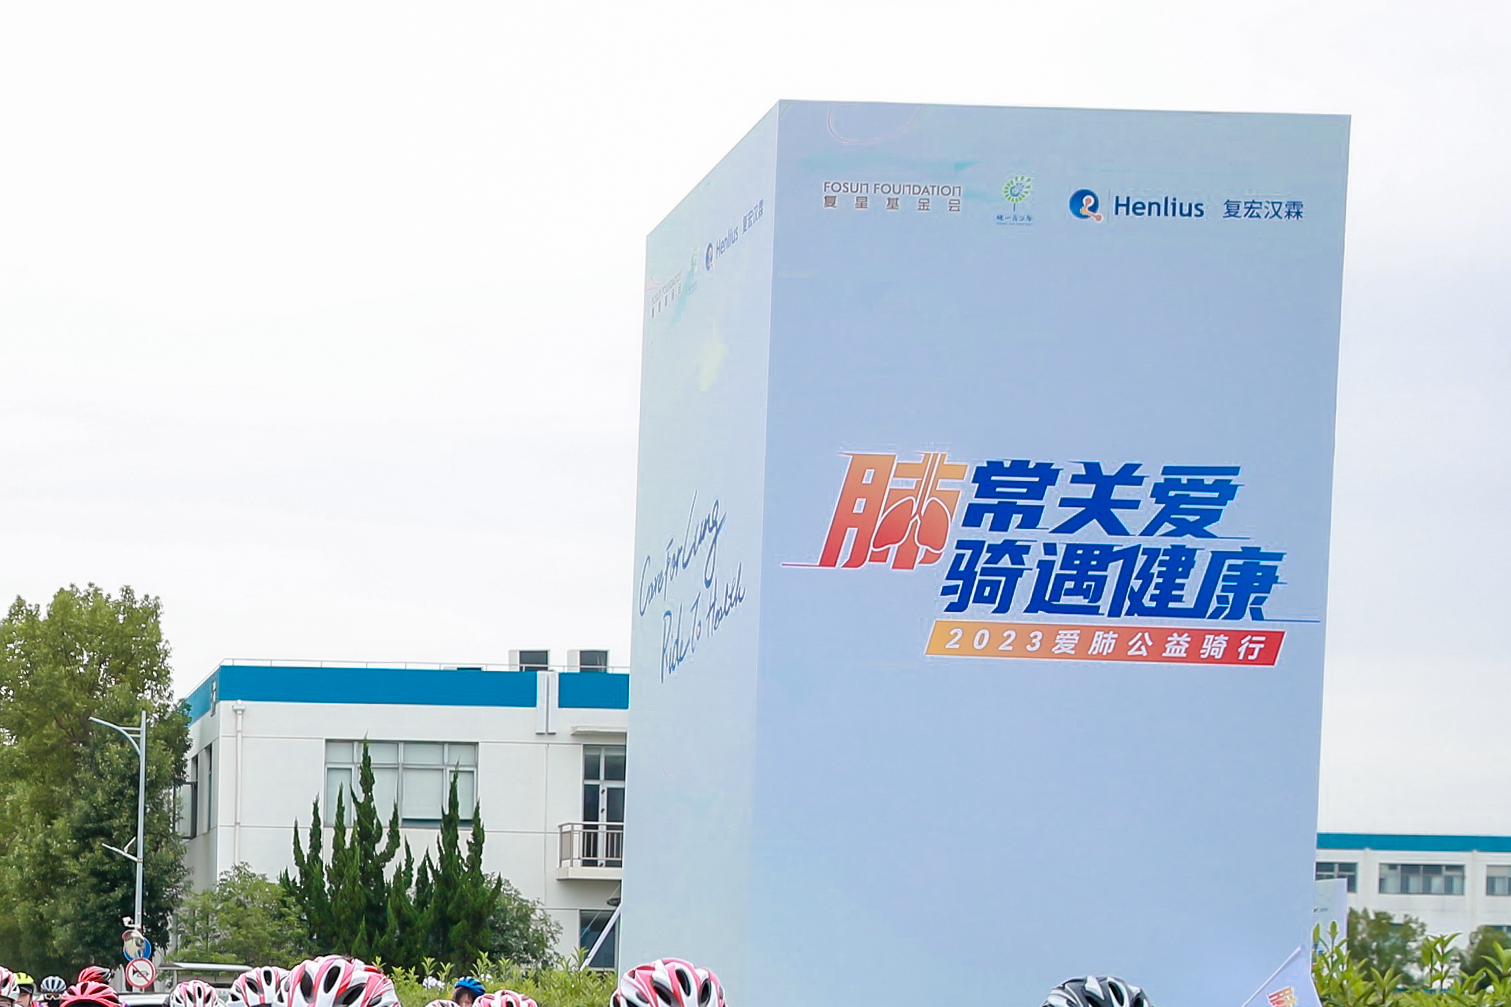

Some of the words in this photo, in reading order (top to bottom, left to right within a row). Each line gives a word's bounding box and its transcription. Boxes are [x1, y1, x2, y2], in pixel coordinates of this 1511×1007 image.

[823, 181, 869, 194] FOSUN
[873, 183, 962, 197] FOUNDATION
[1113, 195, 1205, 218] Henlius
[1222, 199, 1304, 221] 复宏汉霖
[938, 539, 1288, 622] 骑遇健康
[944, 626, 1267, 662] 2023爱肺公益骑行
